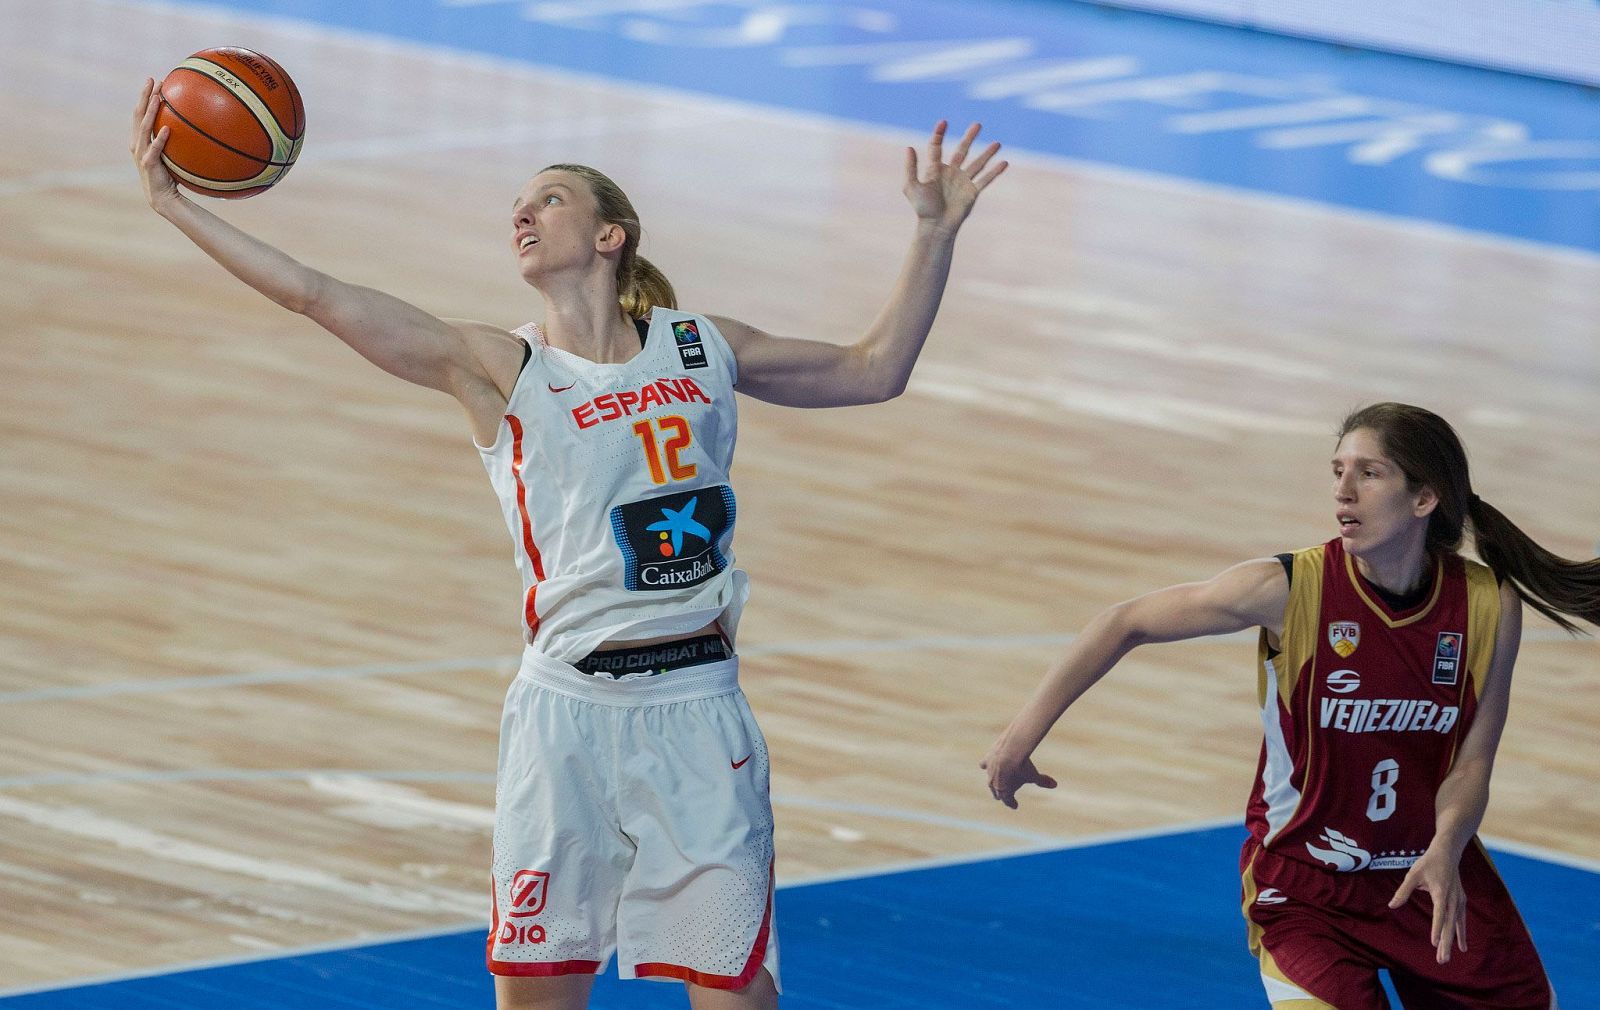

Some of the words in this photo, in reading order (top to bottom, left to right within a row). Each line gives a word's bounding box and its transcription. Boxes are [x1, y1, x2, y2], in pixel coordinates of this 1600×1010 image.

[682, 347, 702, 358] FIBA
[571, 378, 711, 430] ESPAÑA
[632, 414, 698, 486] 12
[641, 554, 715, 585] CaixaBank
[1332, 628, 1356, 638] FVB
[587, 655, 624, 670] PRO
[626, 644, 698, 668] COMBAT
[1437, 661, 1453, 671] FIBA
[1320, 697, 1459, 734] VENEZUELA
[1365, 758, 1400, 822] 8
[1371, 859, 1404, 868] Juventud
